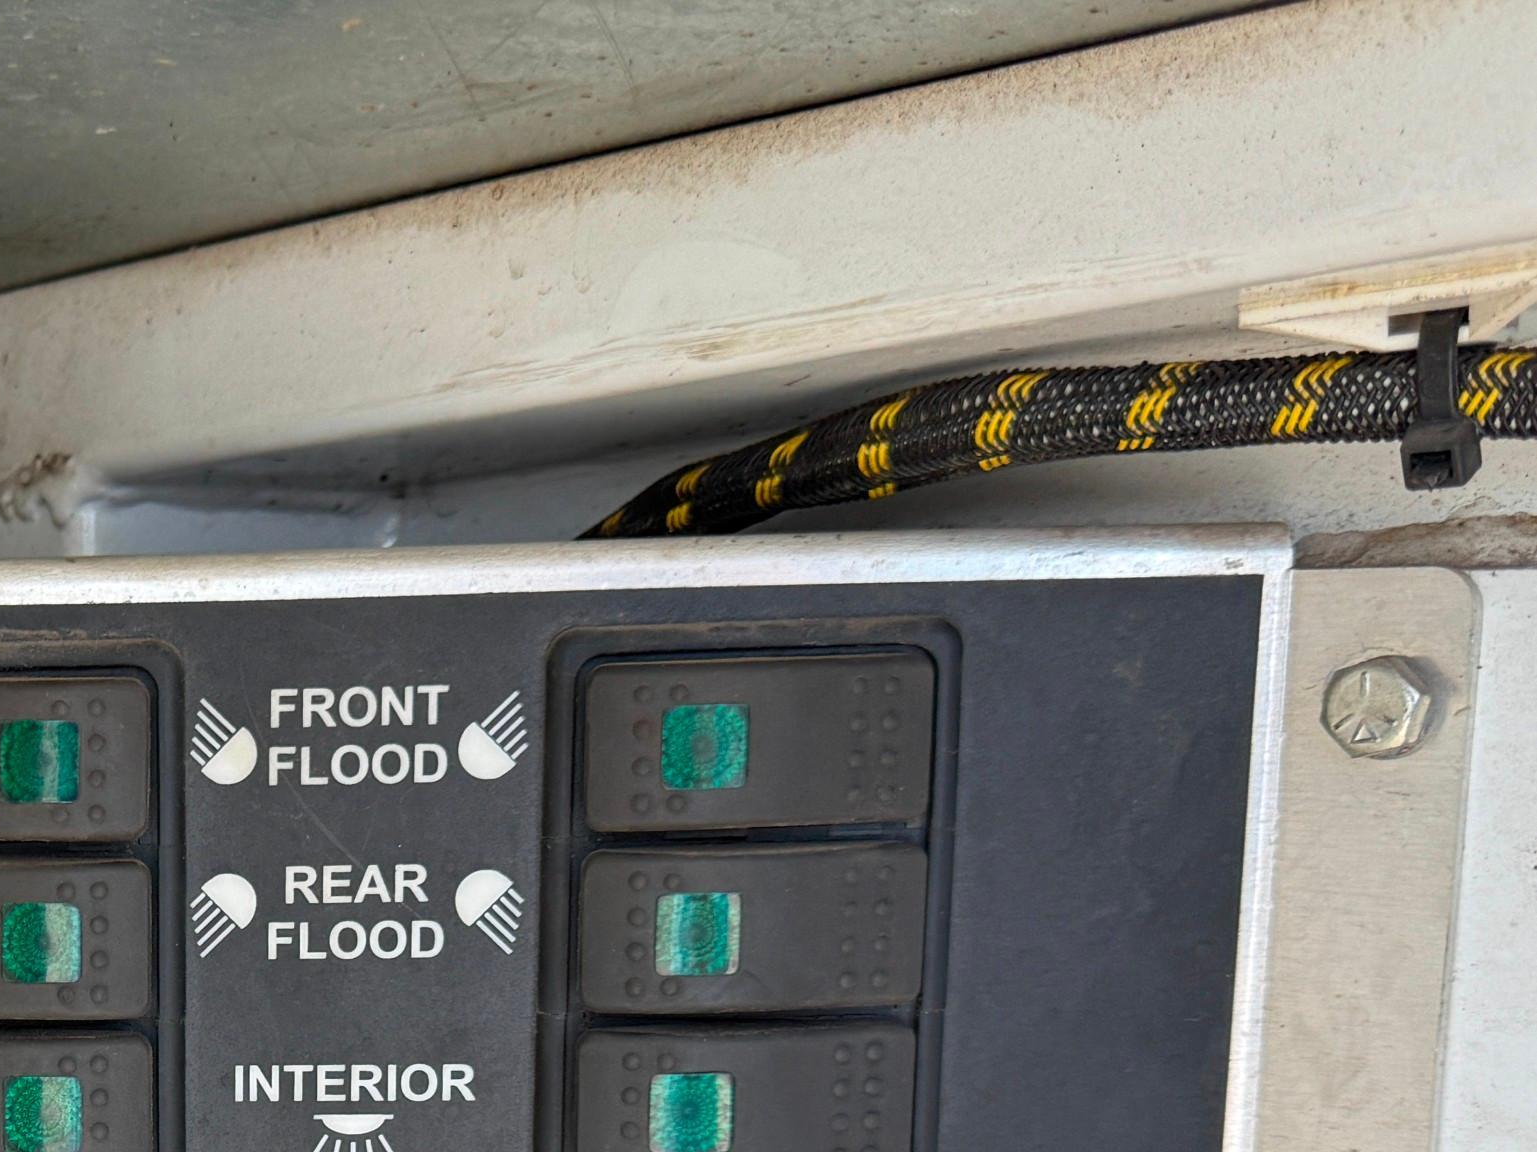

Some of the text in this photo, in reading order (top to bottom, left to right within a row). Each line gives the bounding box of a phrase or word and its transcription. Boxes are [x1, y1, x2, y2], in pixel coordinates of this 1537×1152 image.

[269, 684, 450, 729] FRONT
[268, 743, 448, 786] FLOOD
[285, 863, 429, 905] REAR
[267, 919, 445, 960] FLOOD
[234, 1063, 476, 1102] INTERIOR
